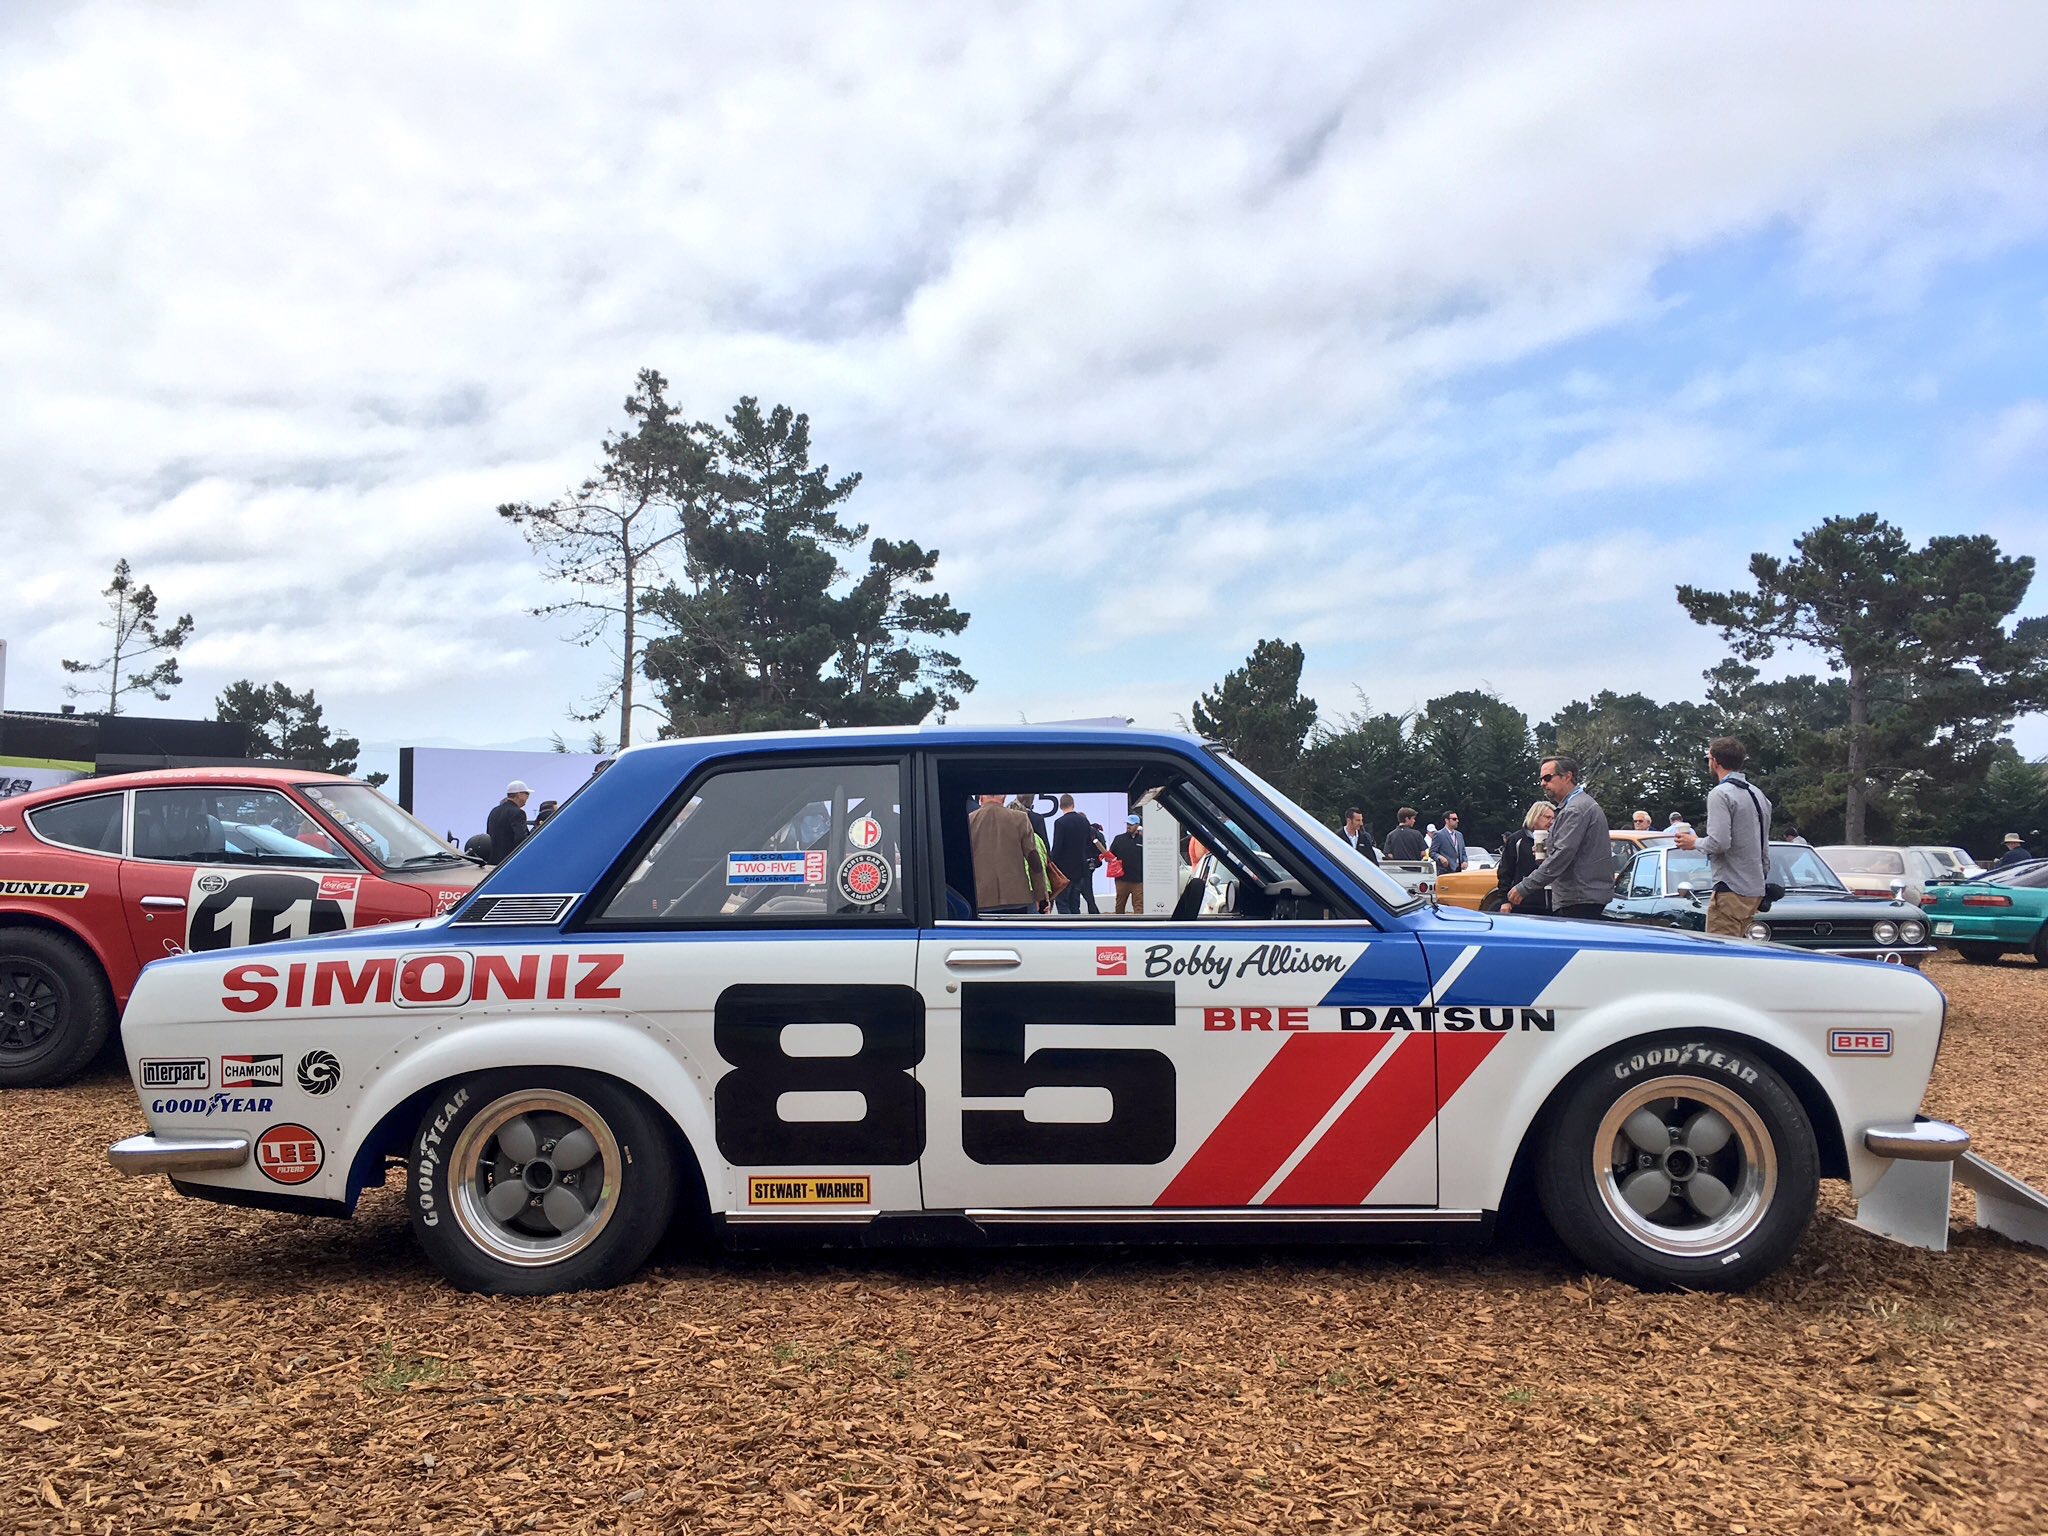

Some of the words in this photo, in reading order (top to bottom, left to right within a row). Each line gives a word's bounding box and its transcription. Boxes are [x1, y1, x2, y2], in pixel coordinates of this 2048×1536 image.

[735, 862, 797, 874] TWO-FIVE
[751, 853, 784, 861] SCCA
[842, 856, 864, 877] SPORTS
[866, 856, 881, 866] CAR
[879, 865, 888, 884] CLUB
[843, 883, 852, 892] OF
[850, 888, 882, 900] AMERICA
[213, 896, 313, 949] 11
[1144, 944, 1233, 990] Bobby
[1235, 944, 1347, 978] Allison
[221, 953, 625, 1014] SIMONIZ
[1203, 1007, 1310, 1032] BRE
[1340, 1006, 1555, 1032] DATSUN
[1837, 1036, 1885, 1048] BRE
[143, 1060, 207, 1086] interpart
[224, 1064, 280, 1078] CHAMPION
[714, 980, 1177, 1167] 85
[262, 1143, 318, 1164] LEE
[276, 1165, 306, 1174] FILTERS
